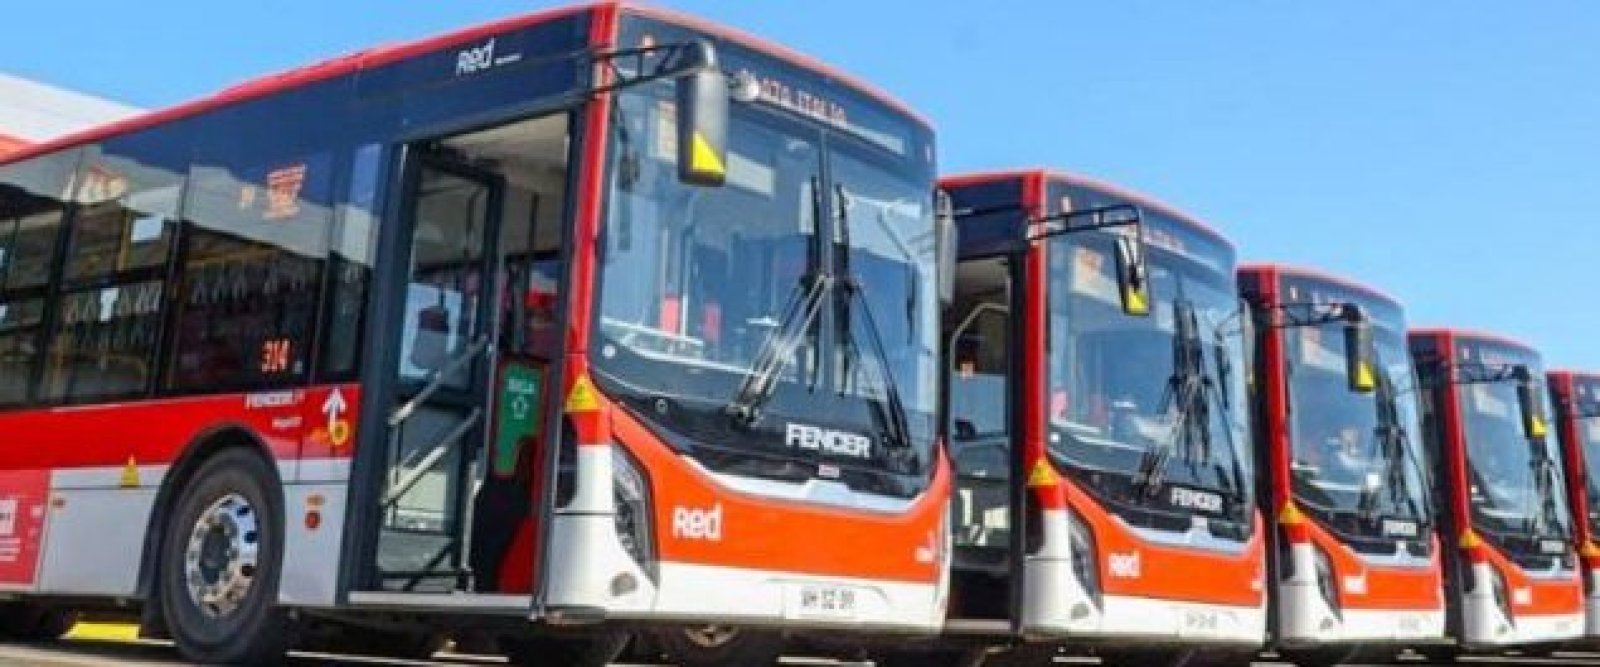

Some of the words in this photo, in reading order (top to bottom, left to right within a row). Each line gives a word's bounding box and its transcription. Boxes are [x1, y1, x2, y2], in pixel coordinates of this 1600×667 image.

[456, 37, 494, 76] Red
[261, 339, 289, 373] 314
[785, 422, 871, 458] FENCER
[1170, 486, 1223, 513] FENCER
[672, 502, 723, 543] Red
